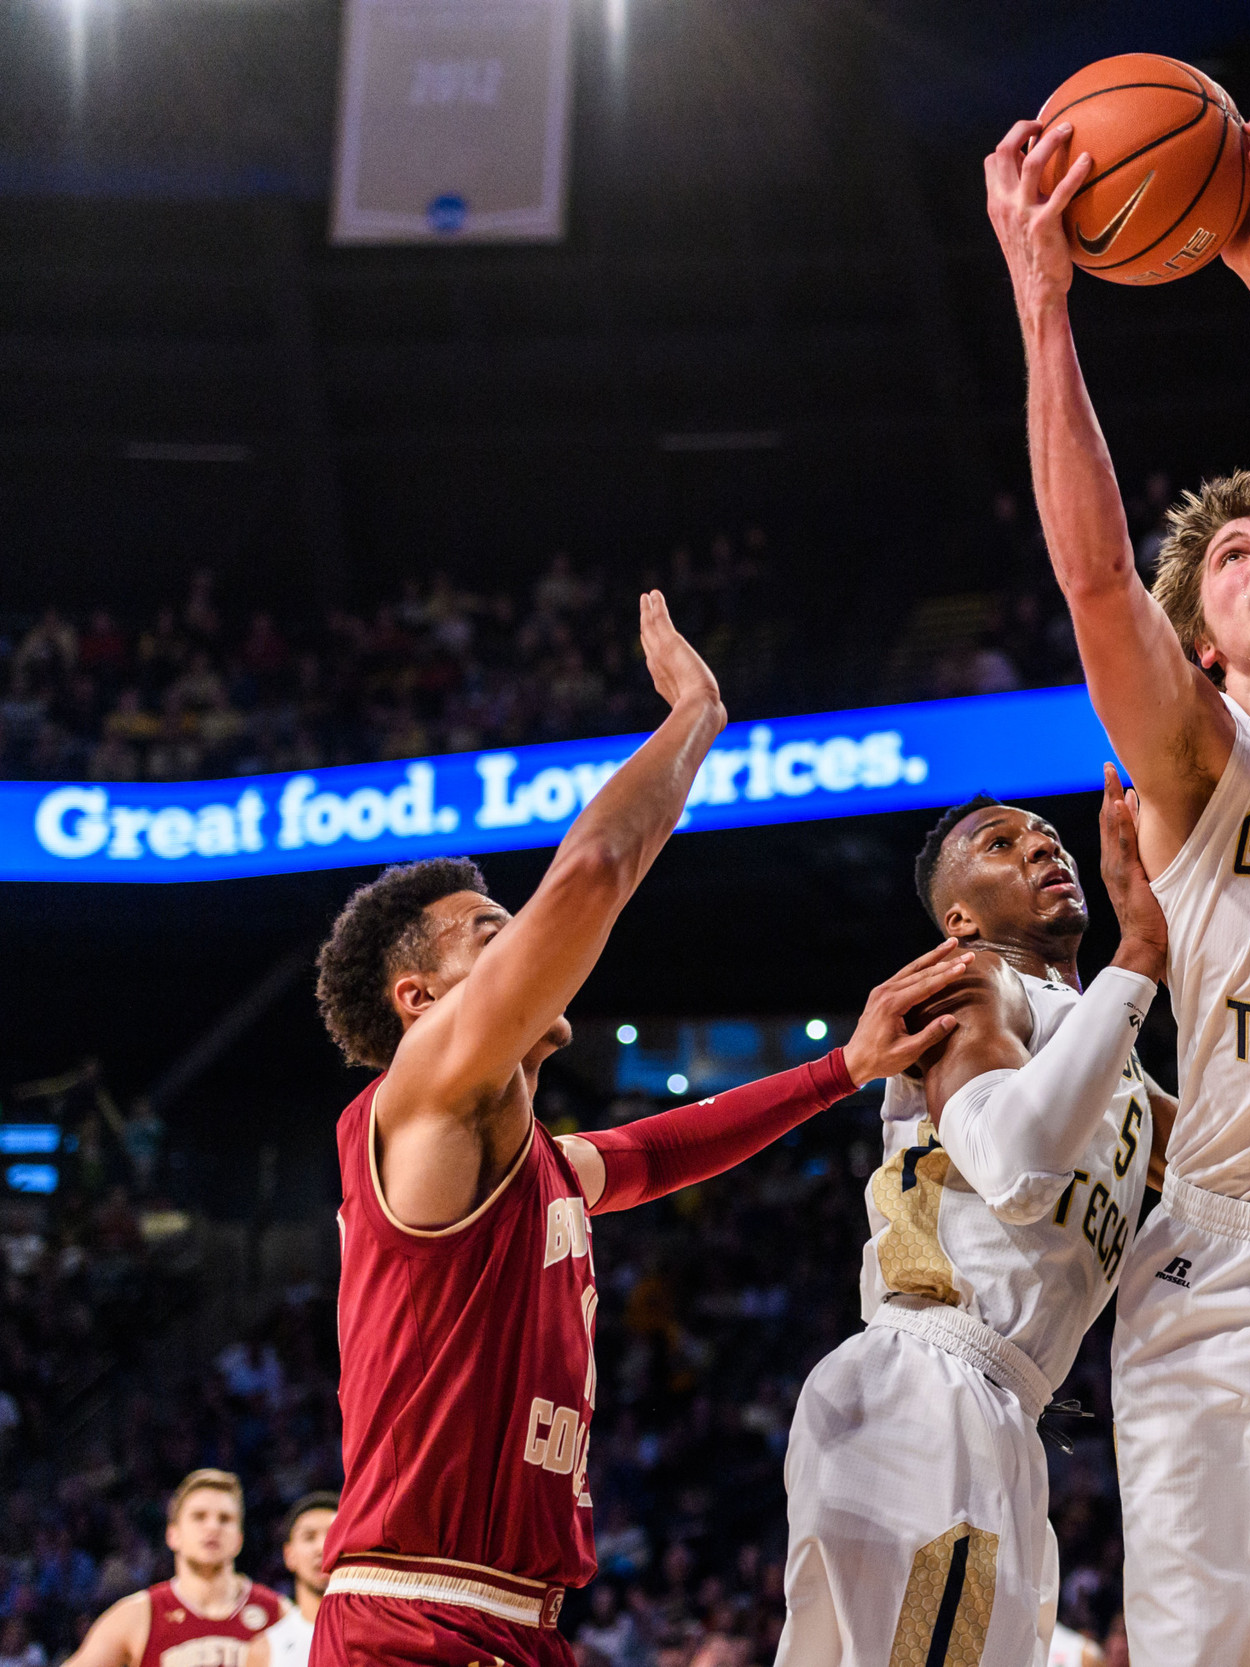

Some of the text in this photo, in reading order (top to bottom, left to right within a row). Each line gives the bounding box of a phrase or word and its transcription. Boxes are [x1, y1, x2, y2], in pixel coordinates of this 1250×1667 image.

[35, 785, 265, 860] Great
[277, 760, 459, 850] food.
[675, 725, 928, 829] rices.
[1113, 1095, 1143, 1181] 5
[1052, 1168, 1129, 1285] TECH
[1155, 1271, 1191, 1289] RUSSELL
